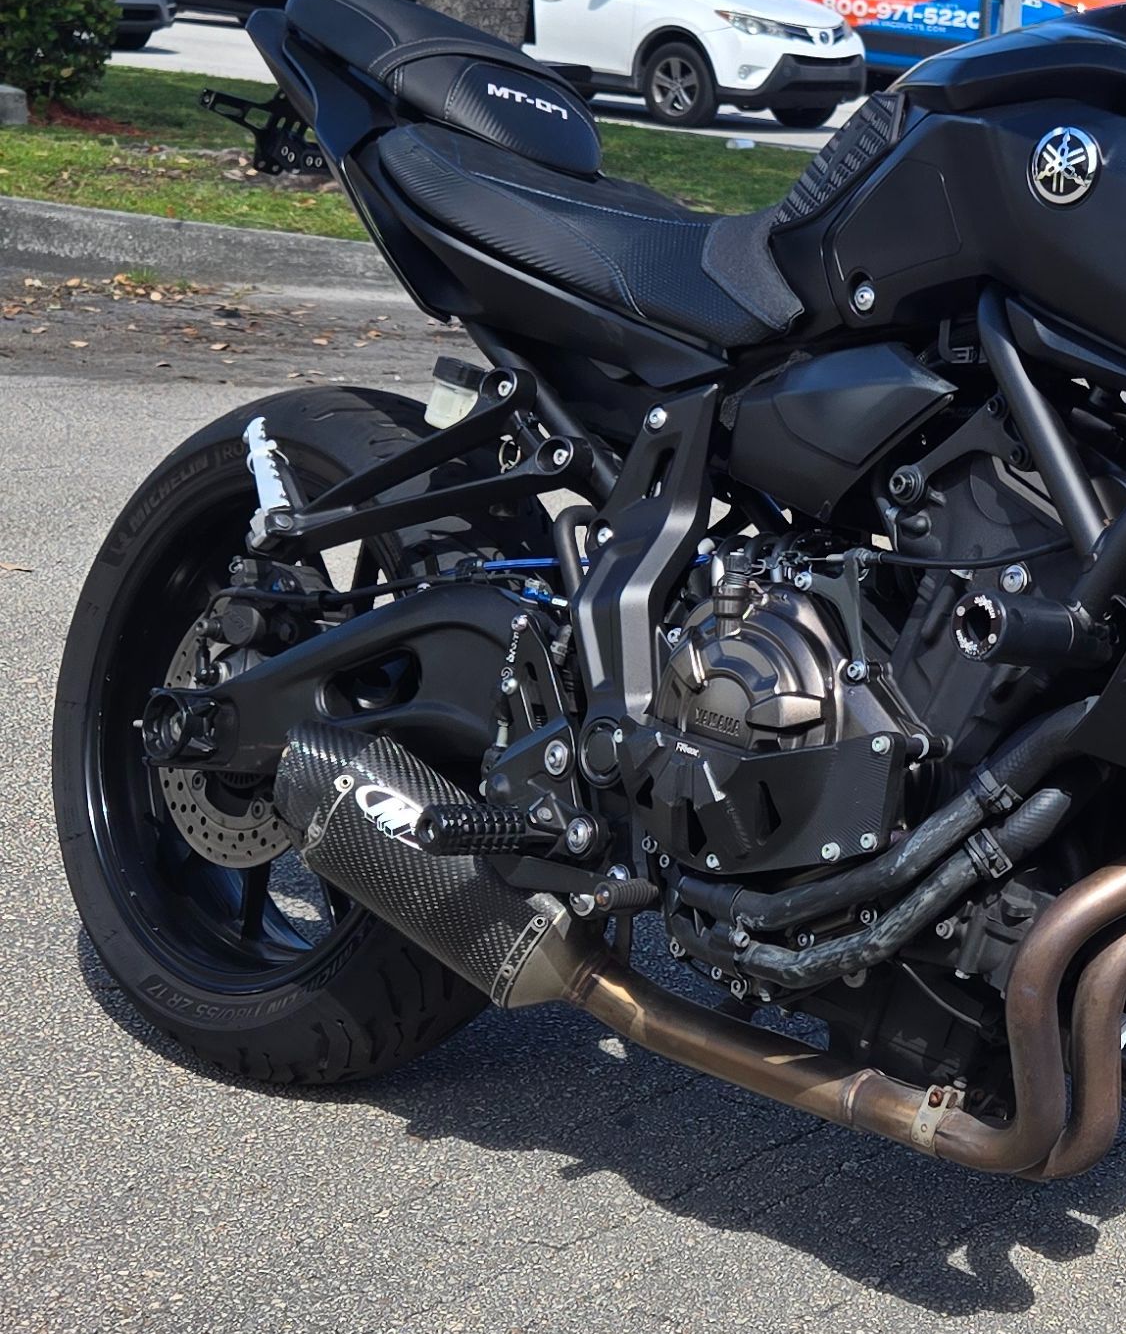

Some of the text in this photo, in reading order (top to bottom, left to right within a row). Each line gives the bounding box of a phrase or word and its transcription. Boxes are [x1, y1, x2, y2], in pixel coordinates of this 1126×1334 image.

[487, 82, 568, 120] MT-07
[131, 457, 209, 533] MICHELIN
[145, 983, 168, 999] 17
